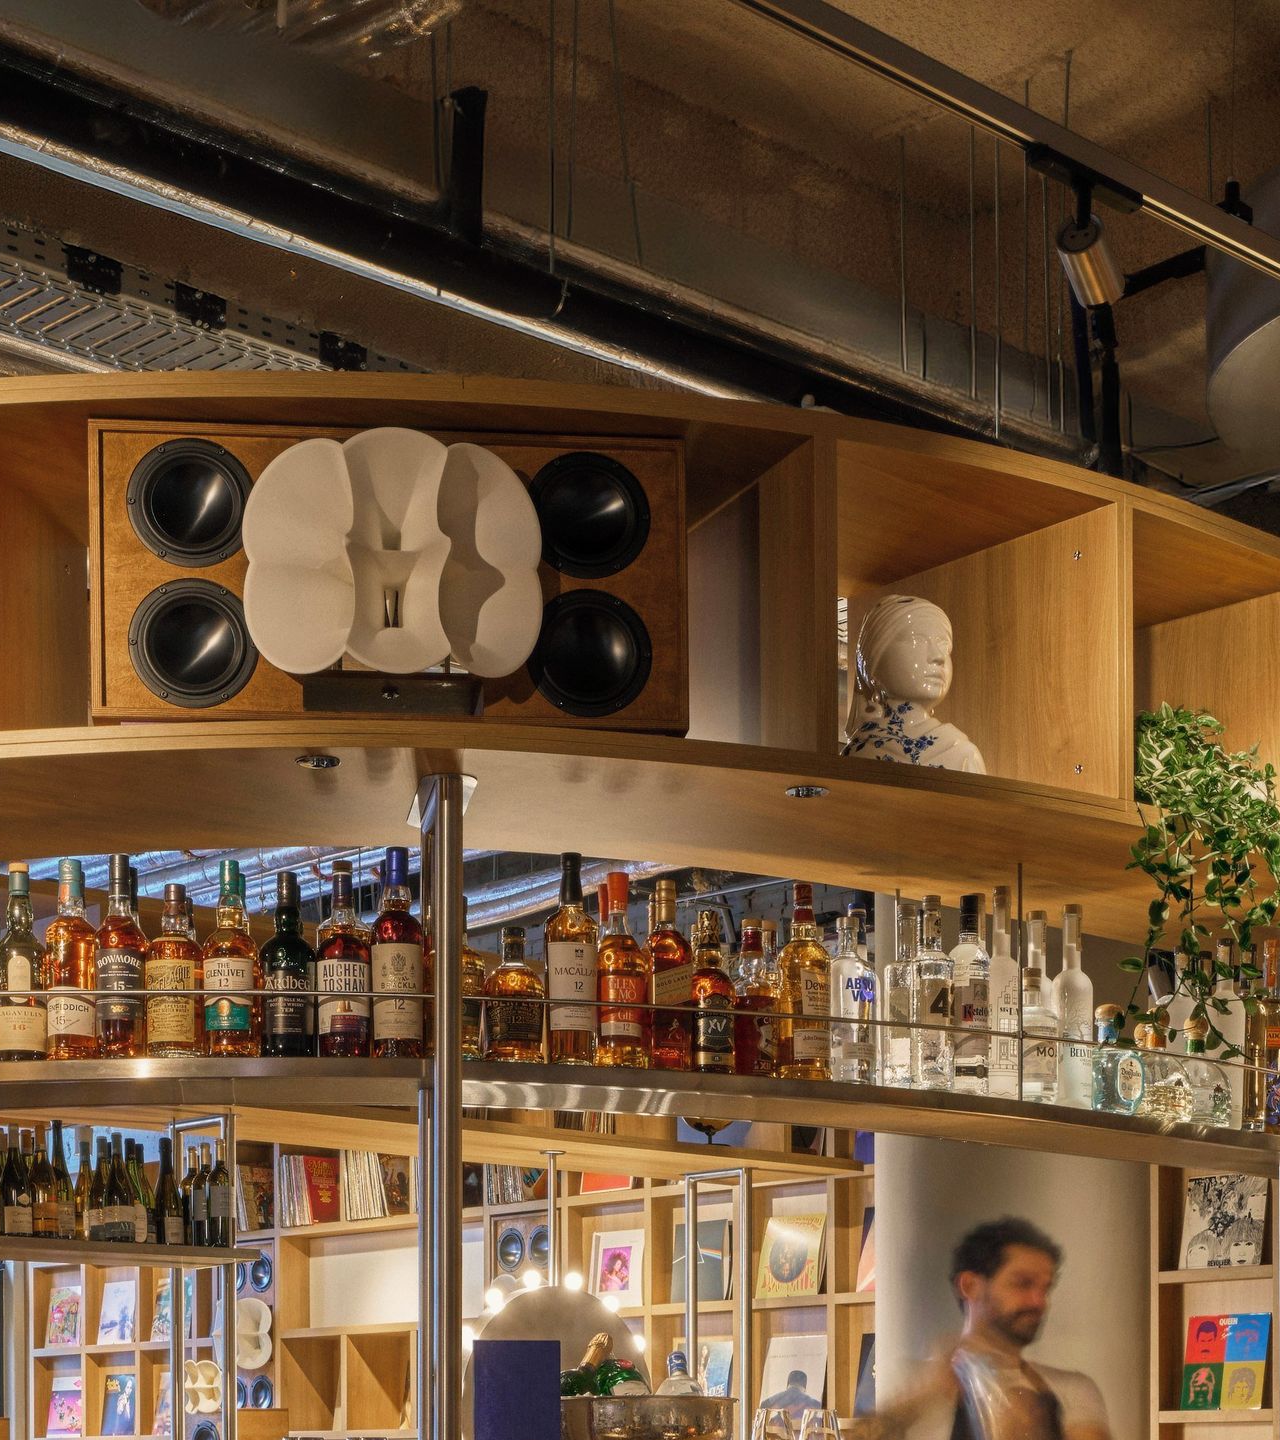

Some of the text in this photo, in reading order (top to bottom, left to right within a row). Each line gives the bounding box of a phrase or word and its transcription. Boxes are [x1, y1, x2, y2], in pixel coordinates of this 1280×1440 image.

[97, 954, 142, 969] BOWMORE
[206, 968, 245, 979] GLENLIVET
[323, 964, 365, 977] AUCHEN
[113, 981, 125, 990] 15
[218, 978, 229, 987] 12
[324, 979, 365, 992] TOSHAN
[574, 981, 584, 990] 12
[609, 978, 636, 990] GLEN
[620, 989, 637, 1000] MO
[393, 998, 406, 1010] 12
[55, 1015, 66, 1025] 15
[708, 1018, 726, 1034] XV
[1207, 1259, 1231, 1268] REVOLVER
[1219, 1317, 1238, 1326] QUEEN
